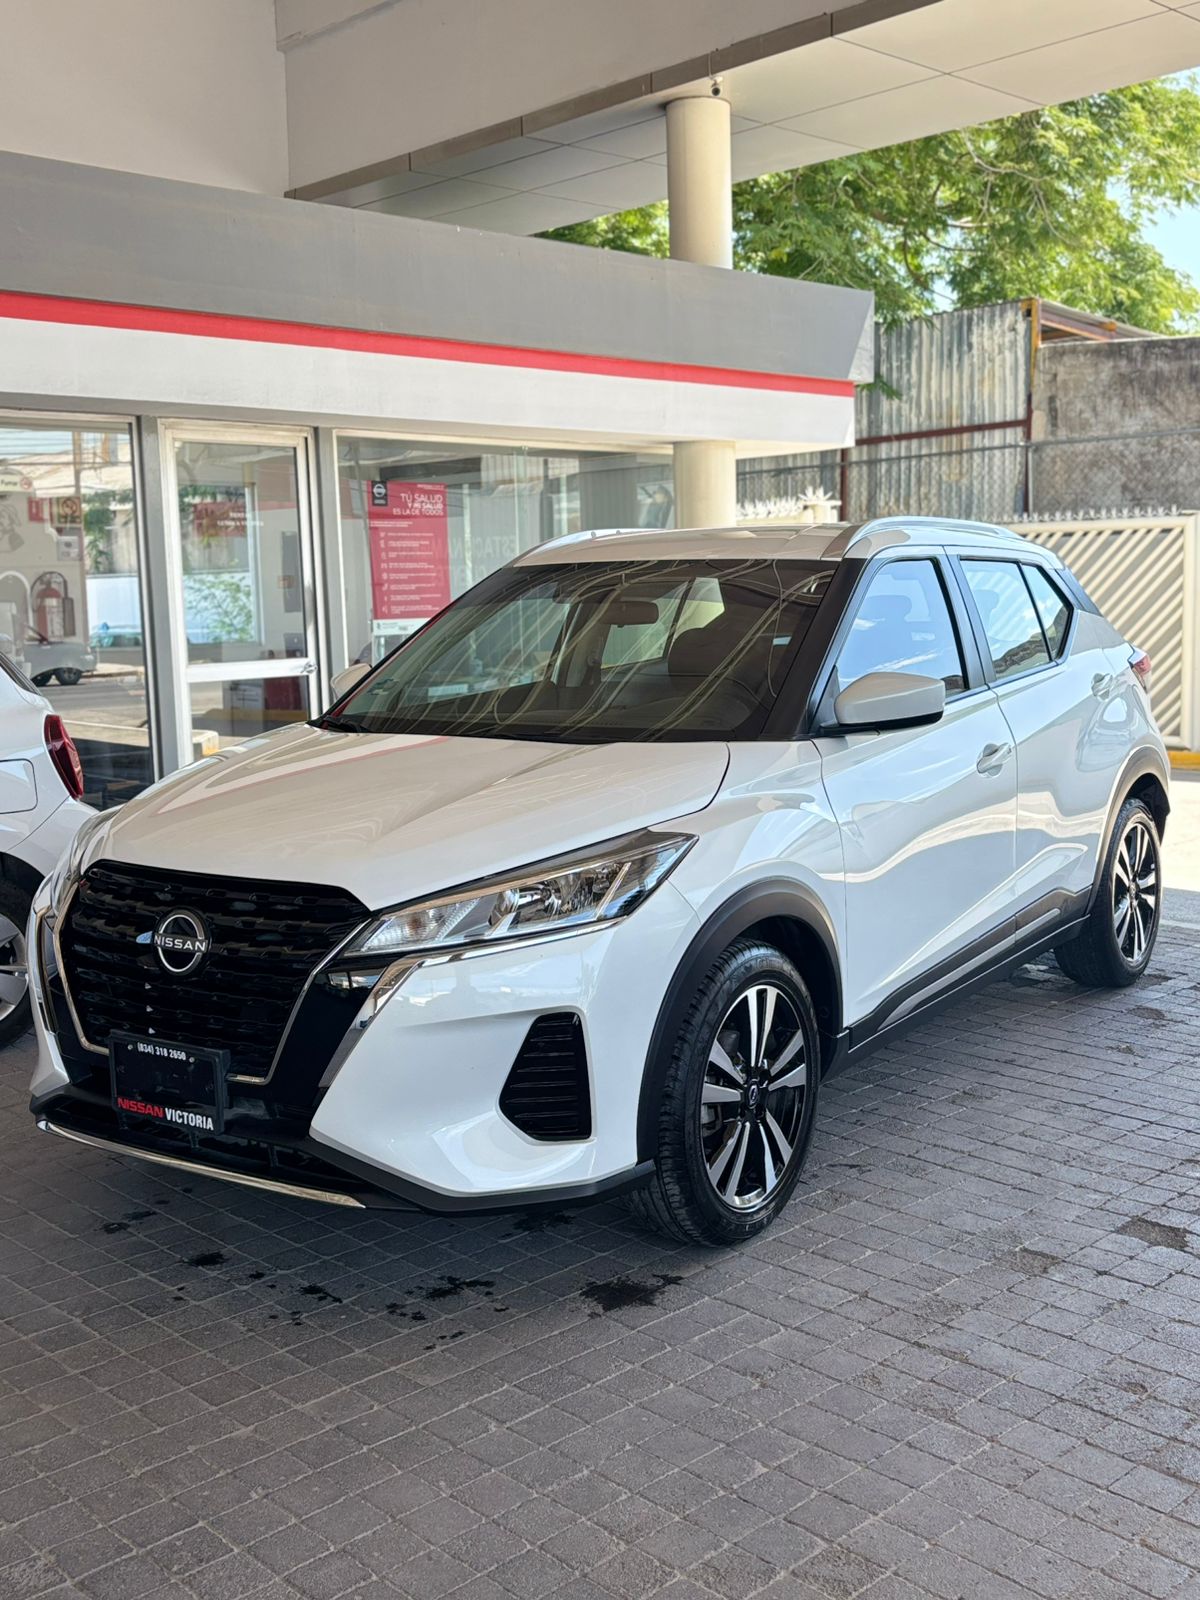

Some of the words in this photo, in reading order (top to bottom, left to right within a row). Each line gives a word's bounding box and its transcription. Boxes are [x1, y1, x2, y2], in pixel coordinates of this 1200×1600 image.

[414, 493, 443, 503] SALUD
[154, 934, 206, 951] NISSAN
[137, 1041, 154, 1055] (834)
[155, 1046, 168, 1057] 318
[117, 1097, 165, 1118] NISSAN
[165, 1107, 214, 1131] VICTORIA
